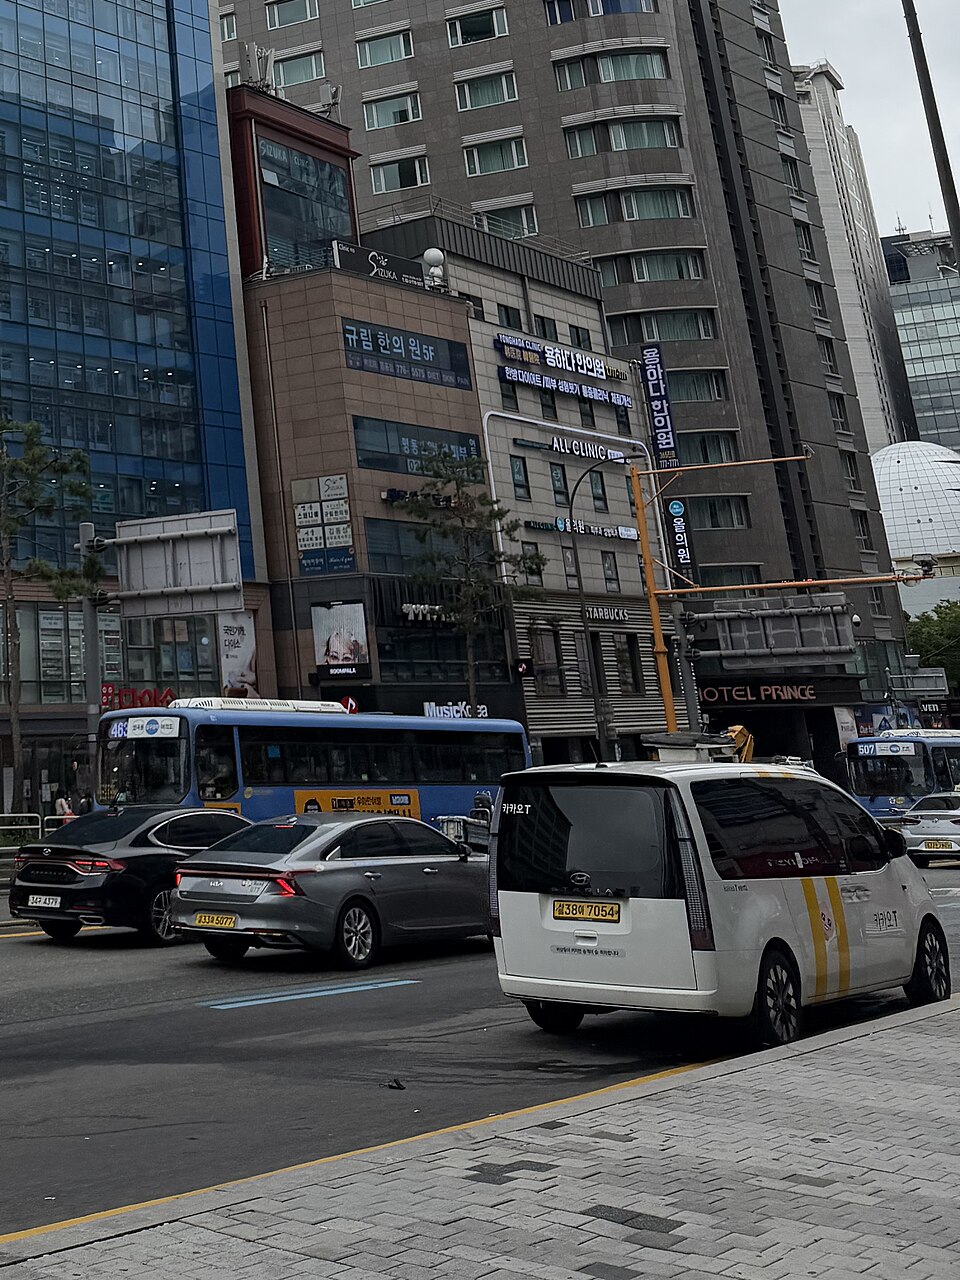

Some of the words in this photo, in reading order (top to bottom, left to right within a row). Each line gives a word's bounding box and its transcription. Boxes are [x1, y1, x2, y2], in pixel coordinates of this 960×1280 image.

[345, 325, 373, 351] 규림
[553, 436, 571, 454] ALL
[572, 440, 606, 460] CLINIC
[760, 684, 817, 701] PRINCE
[859, 744, 875, 754] 507
[502, 803, 532, 815] 카카오T
[587, 905, 615, 918] 7054
